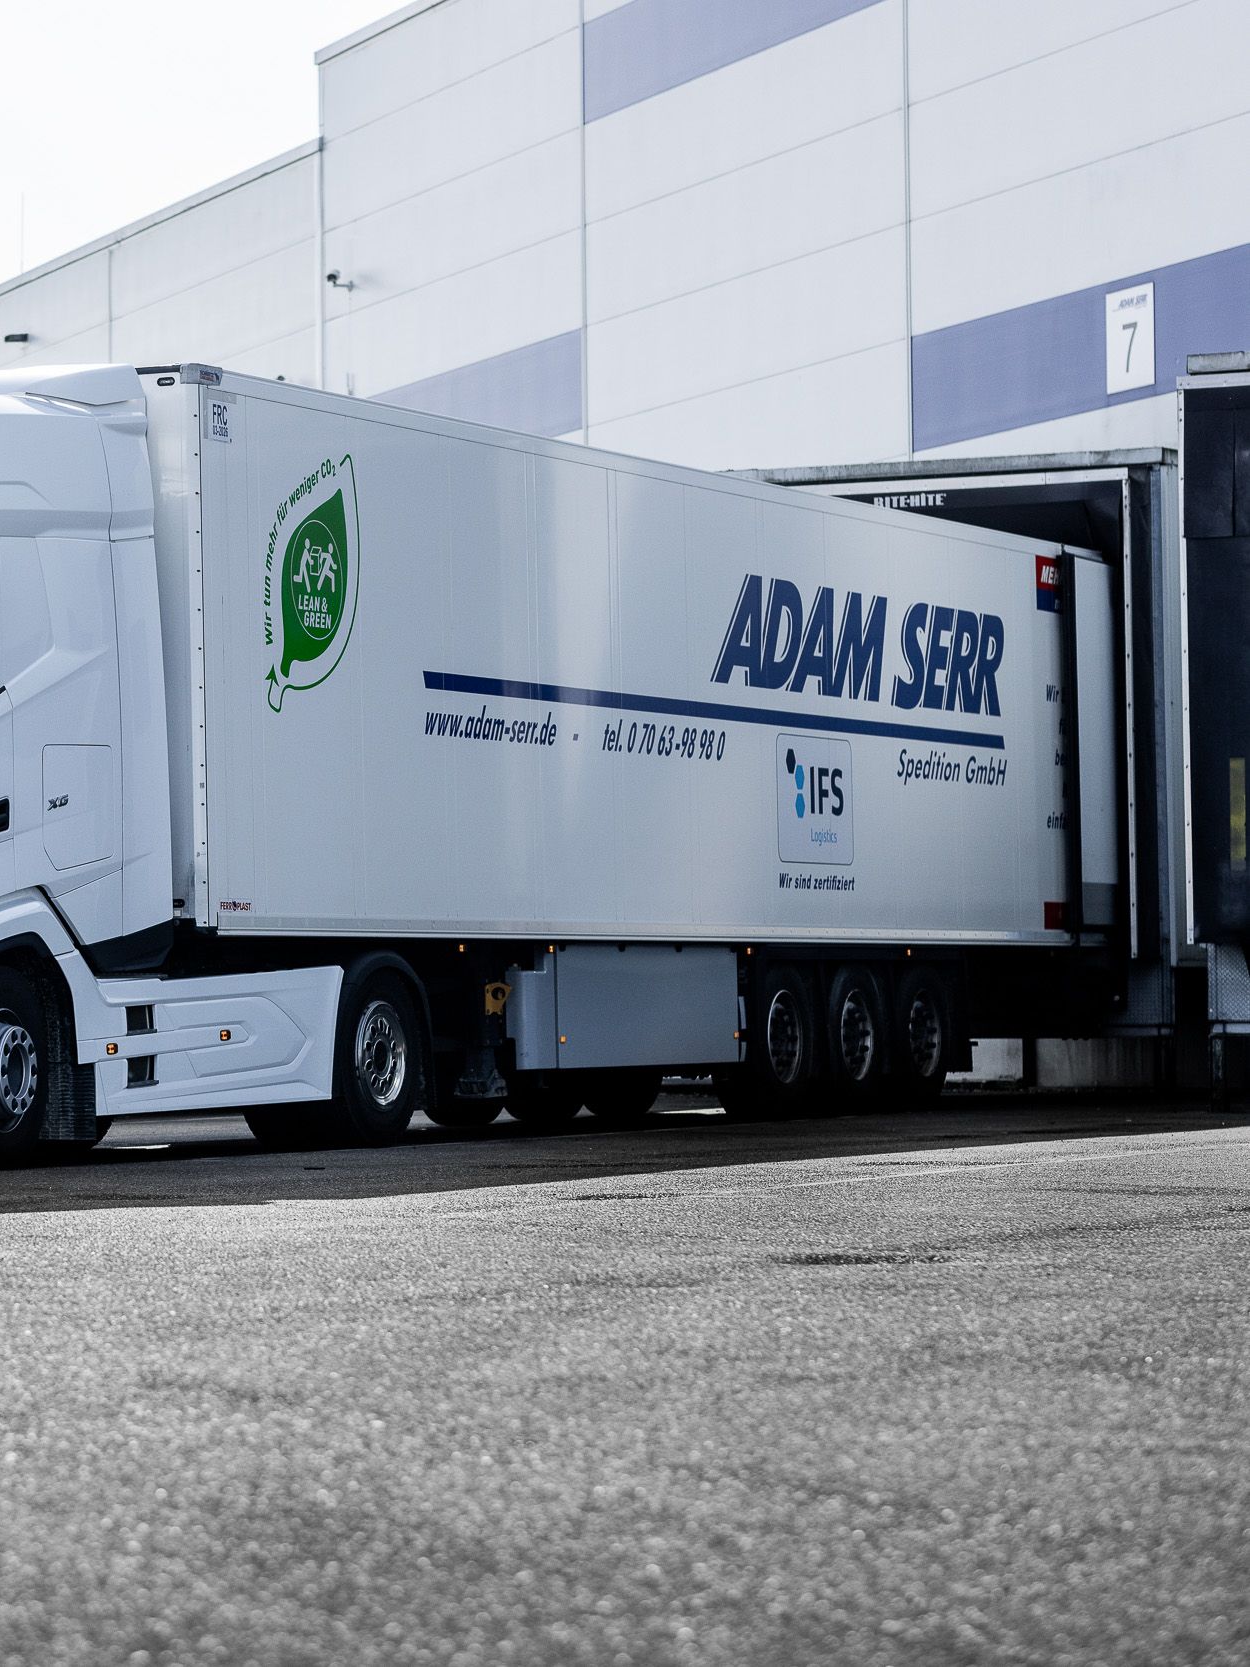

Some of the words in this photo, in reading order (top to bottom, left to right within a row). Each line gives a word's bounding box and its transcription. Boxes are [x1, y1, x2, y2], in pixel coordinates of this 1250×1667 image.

[1122, 322, 1137, 373] 7
[212, 403, 228, 426] FRC
[265, 521, 279, 572] mehr
[276, 498, 288, 527] für
[288, 470, 320, 508] weniger
[298, 593, 320, 611] LEAN
[321, 597, 328, 613] &
[303, 611, 332, 629] GREEN
[710, 573, 888, 702] ADAM
[891, 602, 1005, 717] SERR
[424, 705, 558, 746] www.adam-serr.de
[602, 718, 623, 752] tel.
[627, 721, 638, 753] 0
[638, 723, 655, 755] 70
[699, 729, 714, 759] 98
[716, 731, 726, 761] 0
[897, 749, 961, 786] Spedition
[965, 756, 1008, 786] GmbH
[810, 766, 845, 816] IFS
[810, 828, 838, 846] Logistics
[779, 872, 792, 889] Wir
[794, 873, 812, 890] sind
[813, 874, 855, 891] zertifiziert
